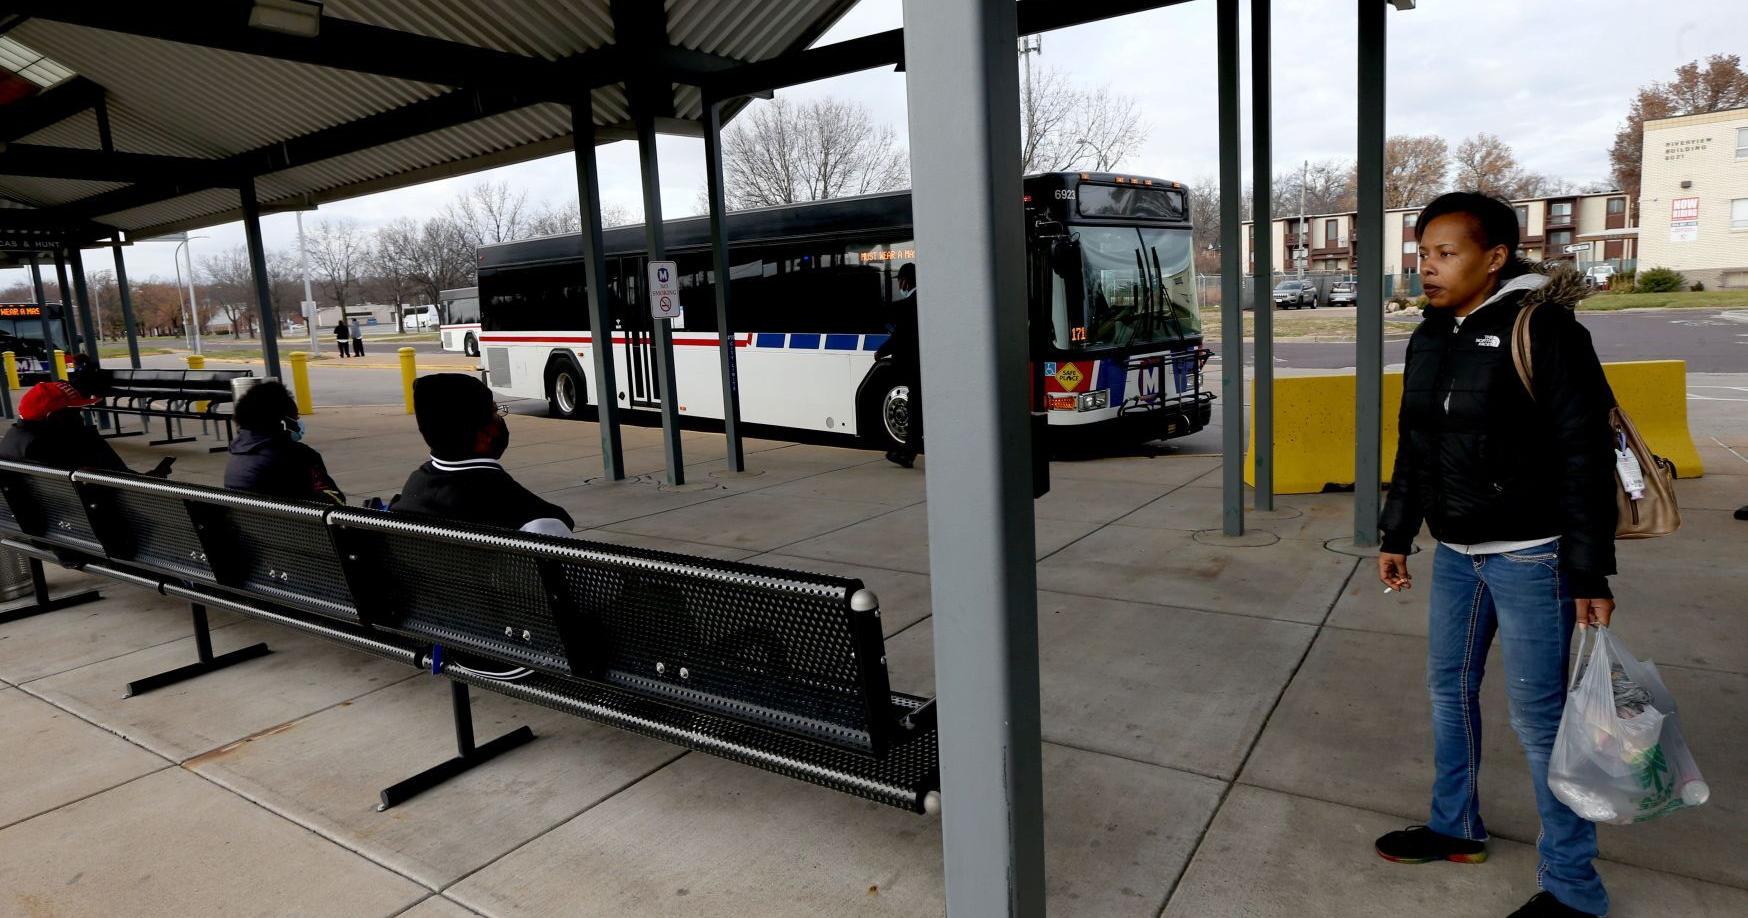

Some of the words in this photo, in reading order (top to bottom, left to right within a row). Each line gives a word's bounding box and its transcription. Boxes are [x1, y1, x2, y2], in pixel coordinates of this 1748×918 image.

[1054, 189, 1076, 200] 6923
[860, 252, 877, 262] MUST
[879, 250, 896, 260] WEAR
[0, 308, 20, 317] WEAR
[1071, 327, 1086, 341] 171
